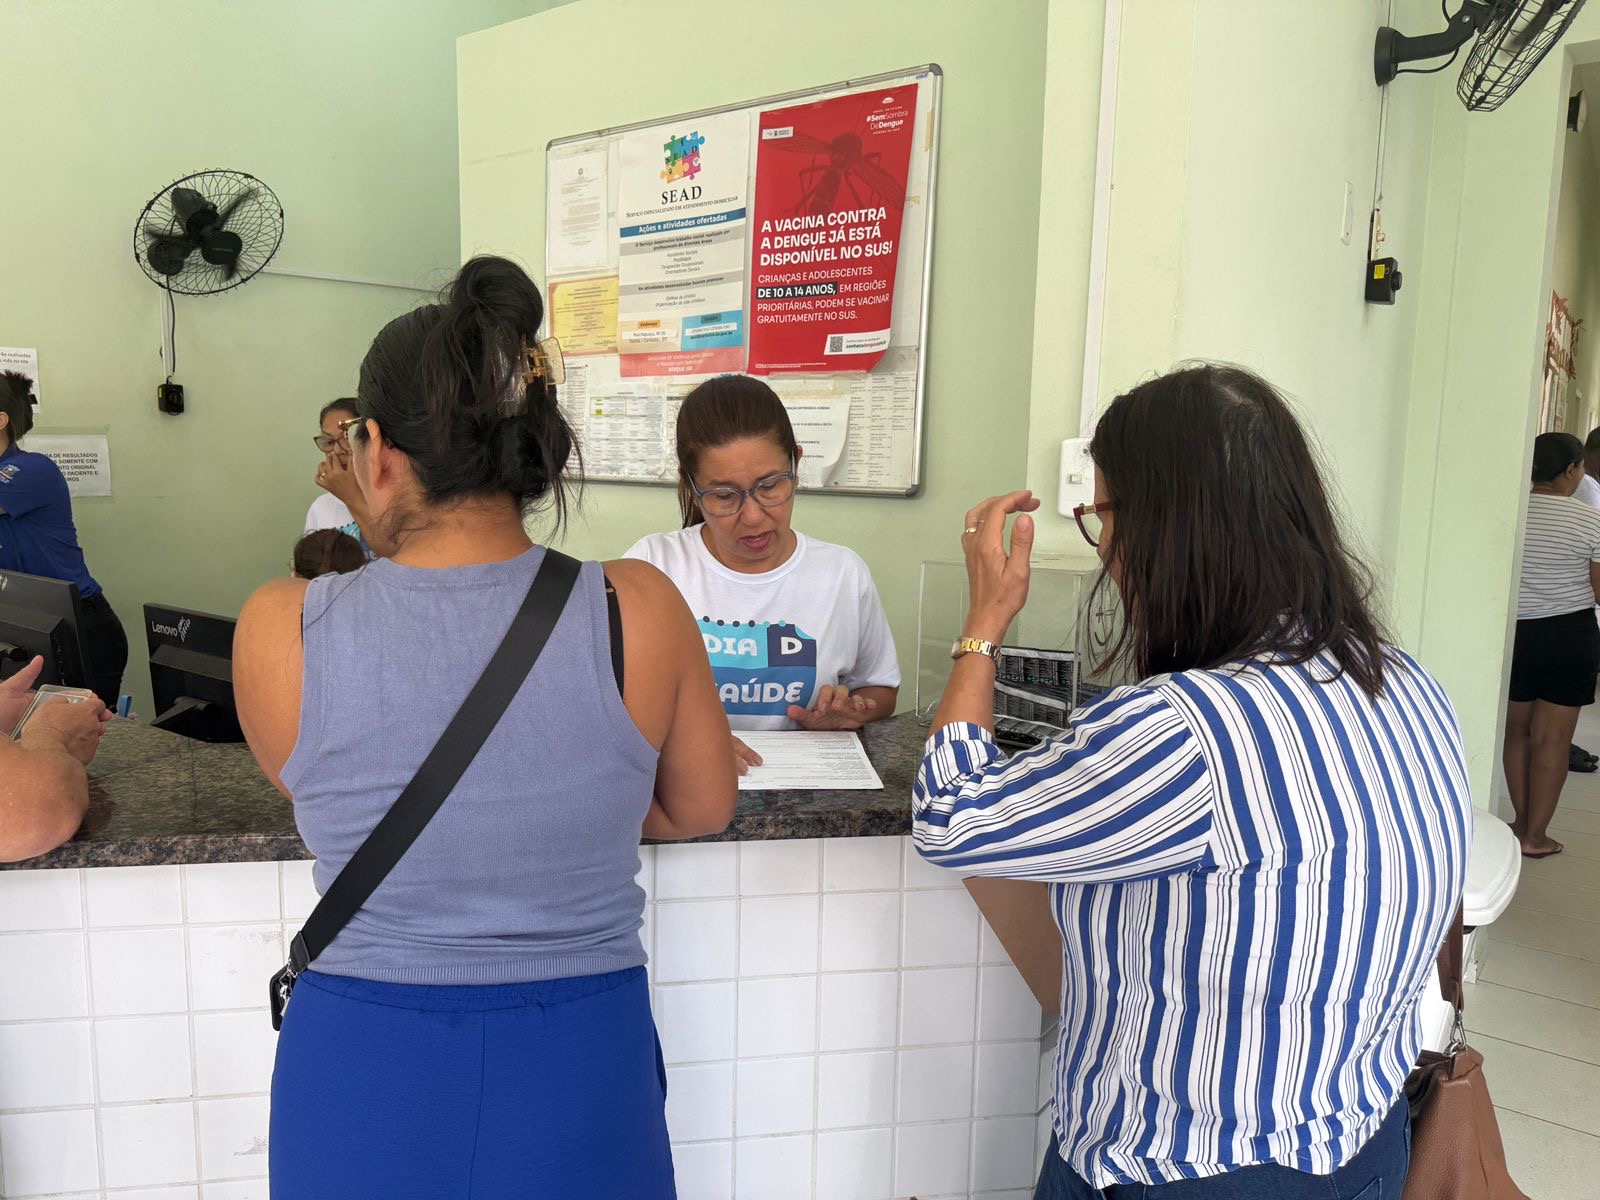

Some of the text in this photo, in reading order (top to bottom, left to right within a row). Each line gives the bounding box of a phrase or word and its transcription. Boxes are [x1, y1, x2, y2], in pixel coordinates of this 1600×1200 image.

[662, 186, 702, 204] SEAD
[639, 224, 656, 234] Ações
[663, 220, 695, 230] atividades
[697, 215, 727, 224] ofertadas
[762, 207, 886, 232] A VACINA CONTRA
[760, 221, 881, 250] A DENGUE JÁ ESTÁ
[760, 241, 893, 266] DISPONÍVEL NO SUS!
[758, 266, 873, 284] CRIANÇAS E ADOLESCENTES
[758, 288, 771, 297] DE
[773, 288, 782, 297] 10
[785, 287, 792, 296] A
[794, 286, 804, 296] 14
[806, 284, 836, 296] ANOS,
[854, 280, 886, 292] REGIÕES
[758, 293, 889, 312] PRIORITÁRIAS, PODEM SE VACINAR
[757, 311, 857, 324] GRATUITAMENTE NO SUS.
[152, 620, 178, 636] Lenovo
[702, 633, 802, 656] DIA D
[716, 677, 804, 704] AÚDE
